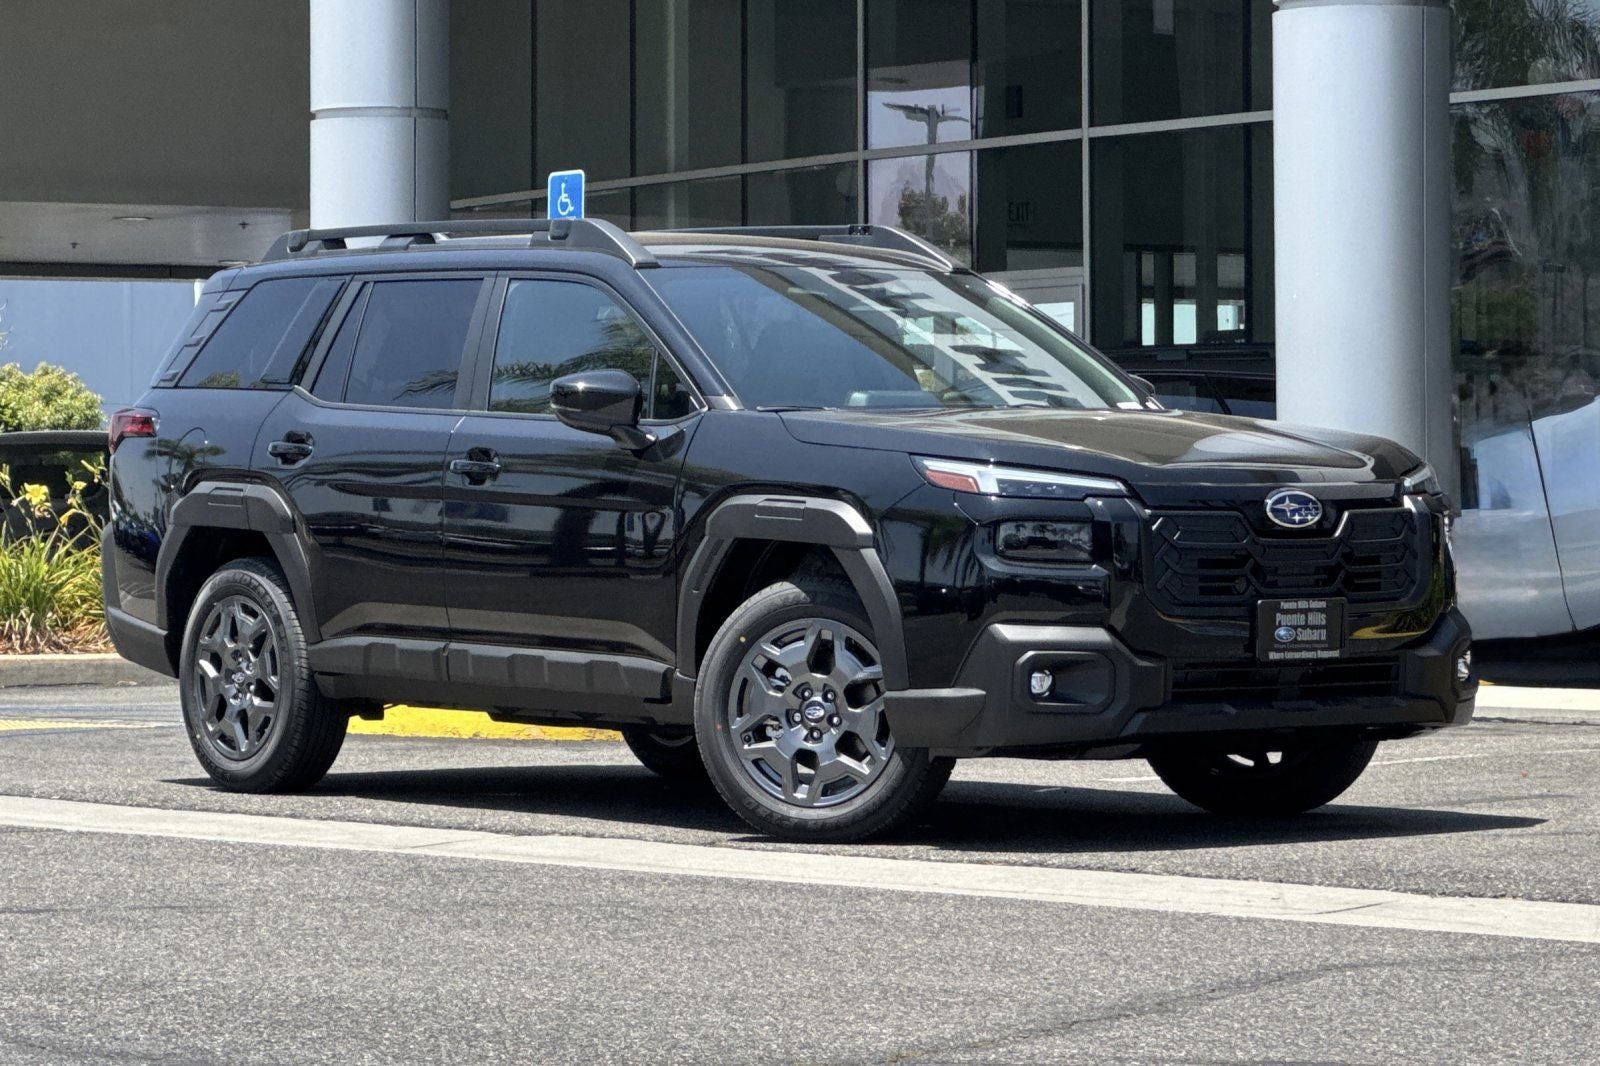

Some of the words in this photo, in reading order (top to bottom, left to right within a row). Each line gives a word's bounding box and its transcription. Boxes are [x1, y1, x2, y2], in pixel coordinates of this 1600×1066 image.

[1276, 612, 1306, 626] Puente
[1308, 611, 1326, 625] Hills
[1297, 627, 1326, 641] Subaru
